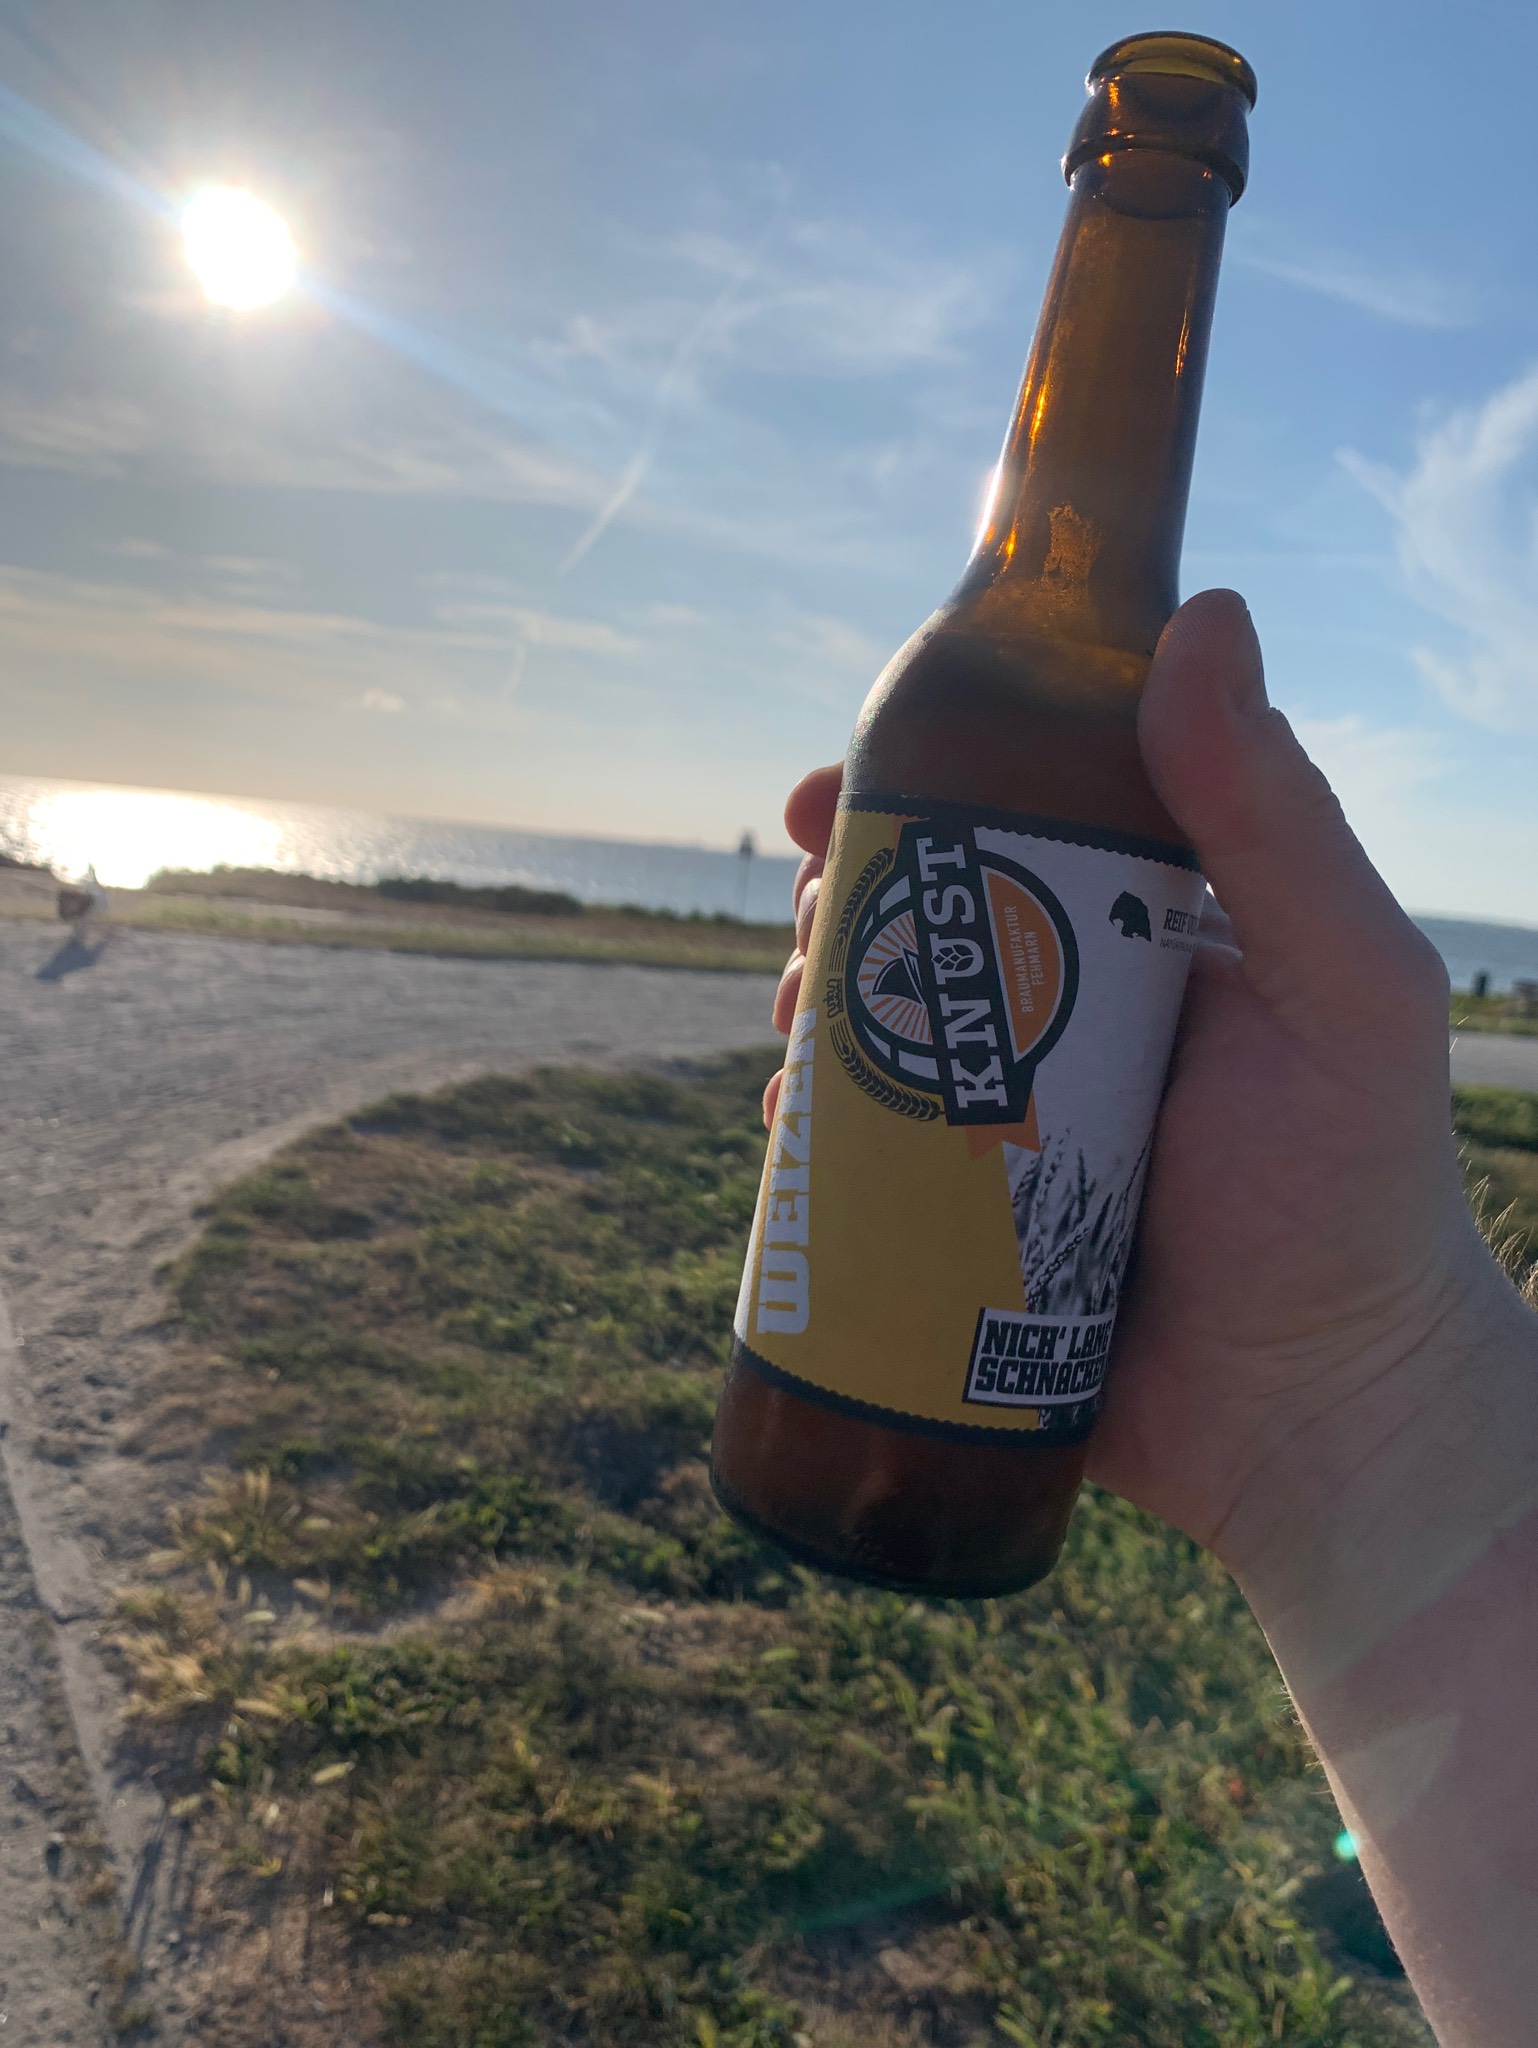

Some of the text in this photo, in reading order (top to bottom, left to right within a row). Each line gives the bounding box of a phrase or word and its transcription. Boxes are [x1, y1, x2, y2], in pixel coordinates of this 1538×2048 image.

[1005, 905, 1035, 1013] BRAUMANUFAKTUR
[1025, 930, 1045, 987] FEHMARN
[1163, 908, 1189, 934] REIF
[916, 836, 1009, 1109] KNUST
[756, 1007, 817, 1334] WEIZEN
[981, 1319, 1113, 1360] NICH' LANG
